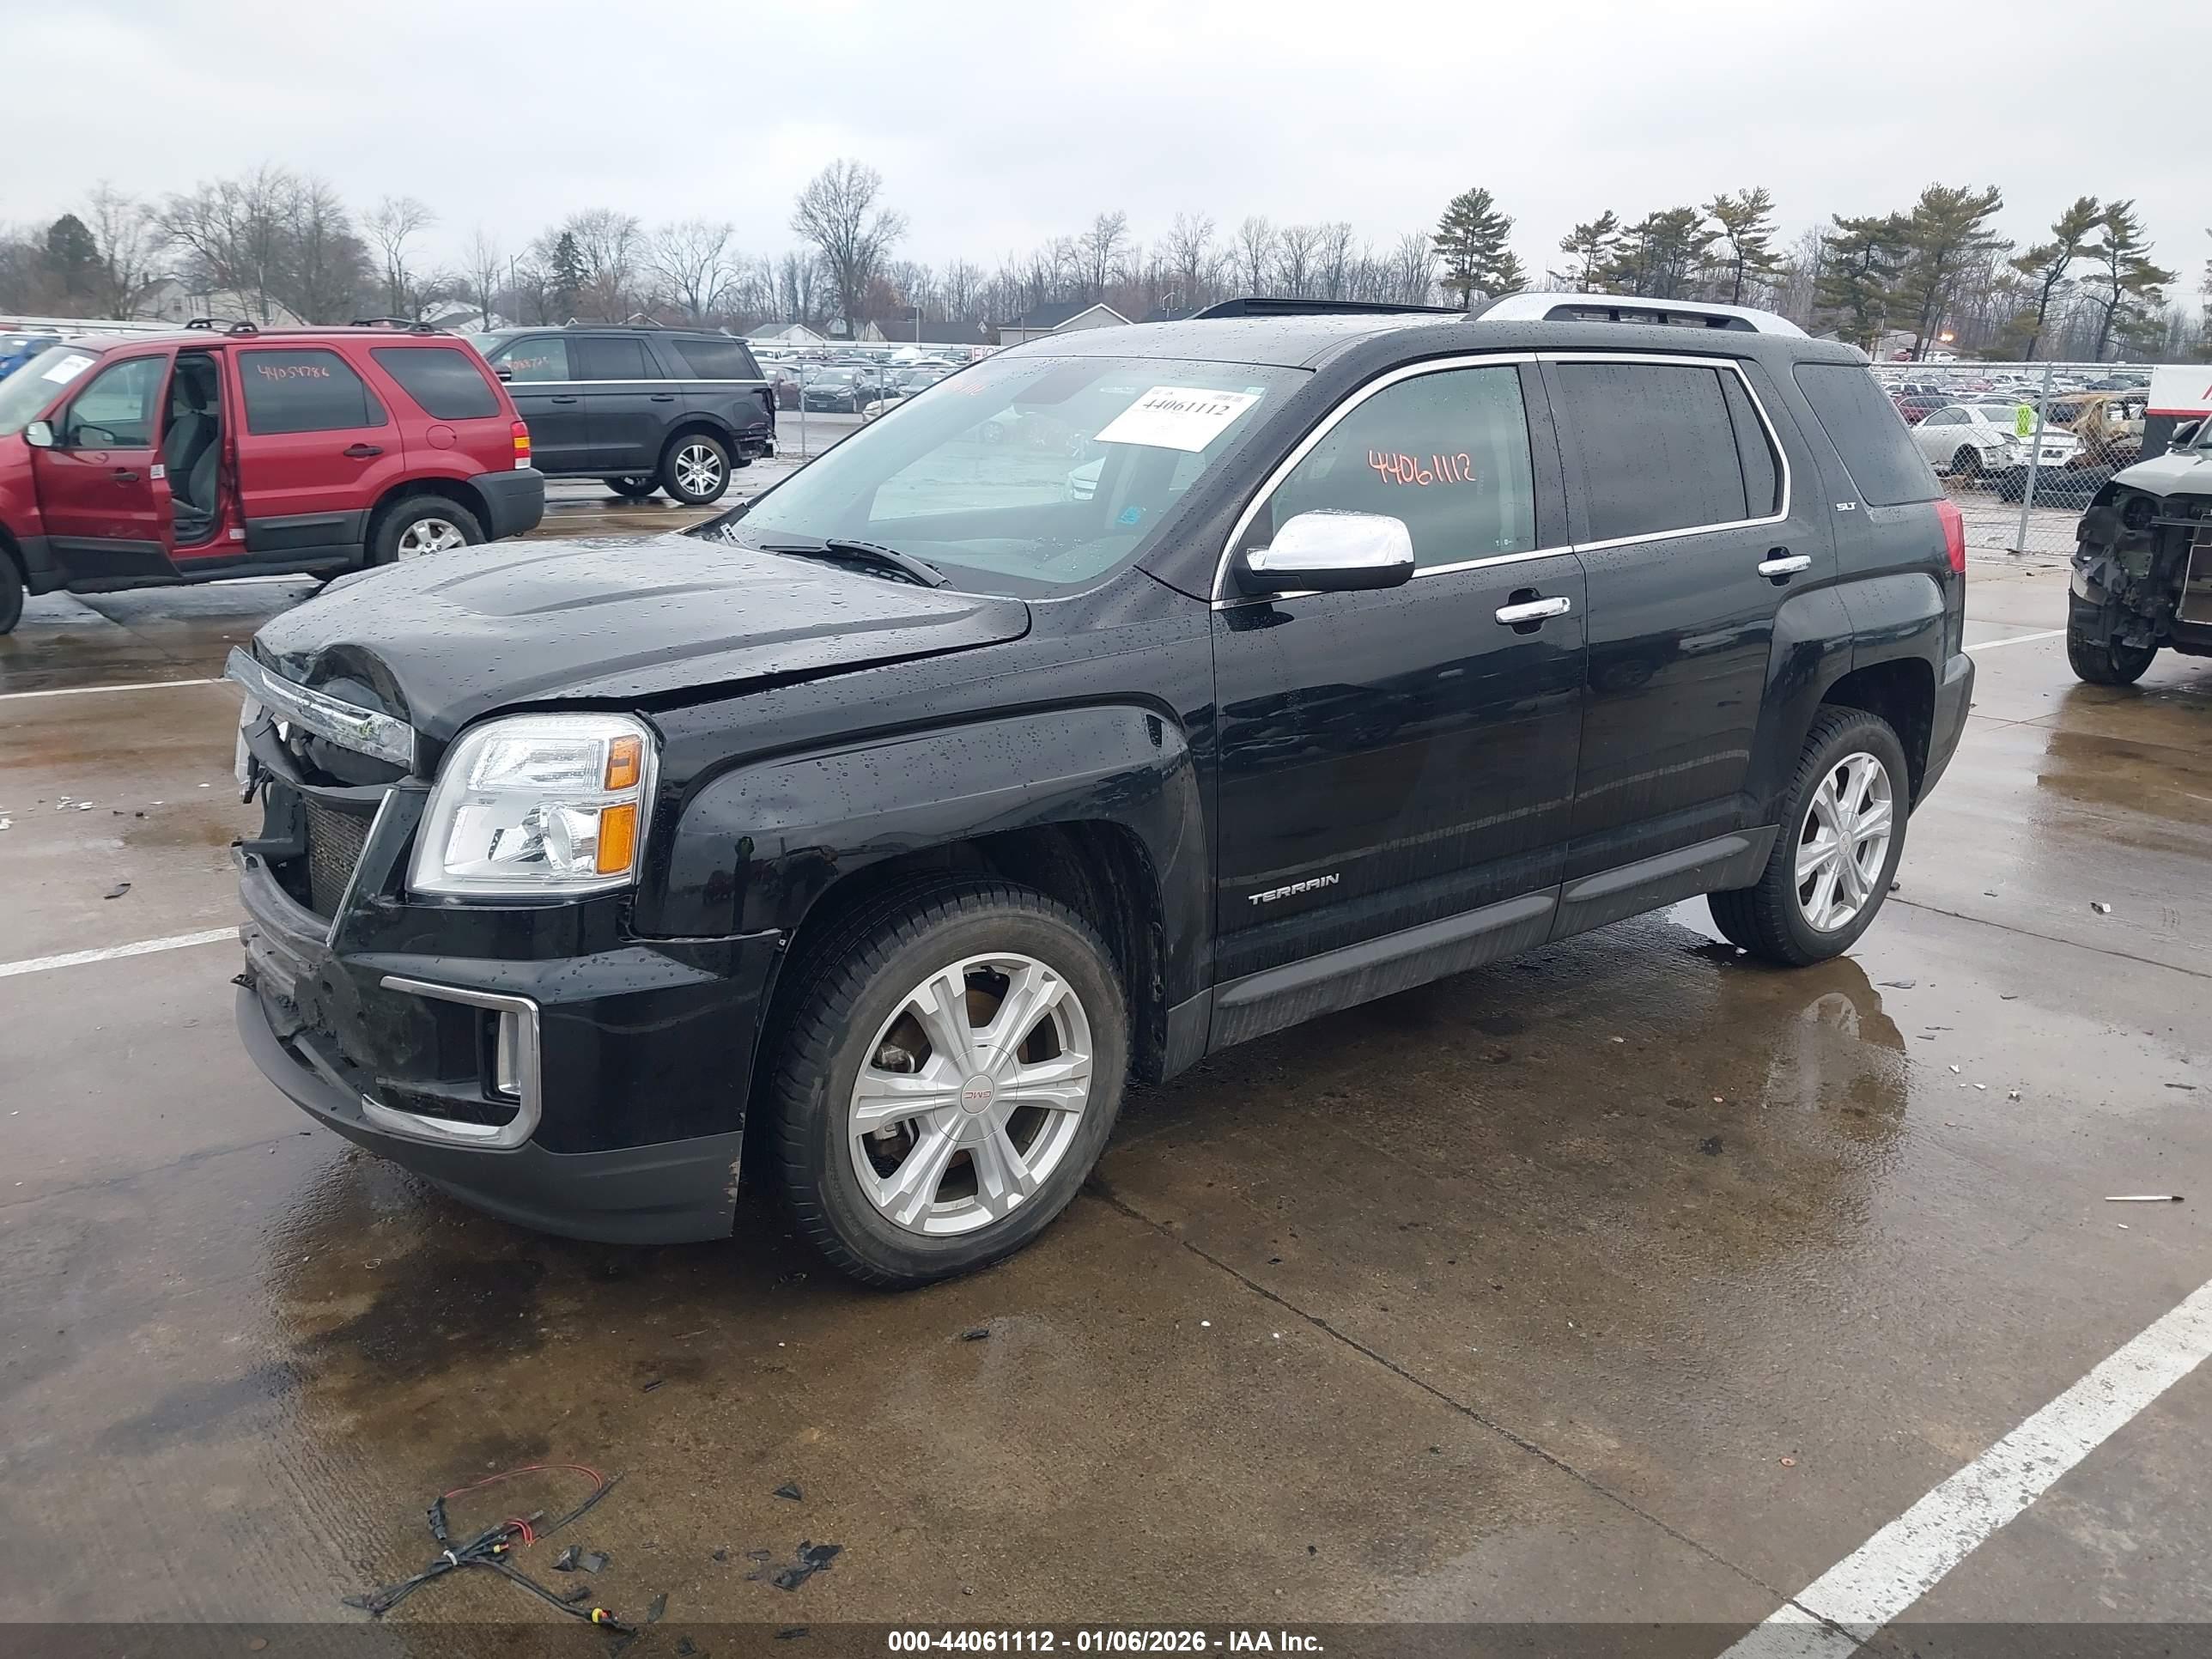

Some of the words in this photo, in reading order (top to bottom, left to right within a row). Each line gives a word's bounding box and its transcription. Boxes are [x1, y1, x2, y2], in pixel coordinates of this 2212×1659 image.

[1142, 398, 1231, 416] 44061112
[1368, 449, 1477, 486] 44061112
[1836, 501, 1856, 512] SLT
[1248, 872, 1340, 905] TERRAIN
[963, 1091, 992, 1099] GMC
